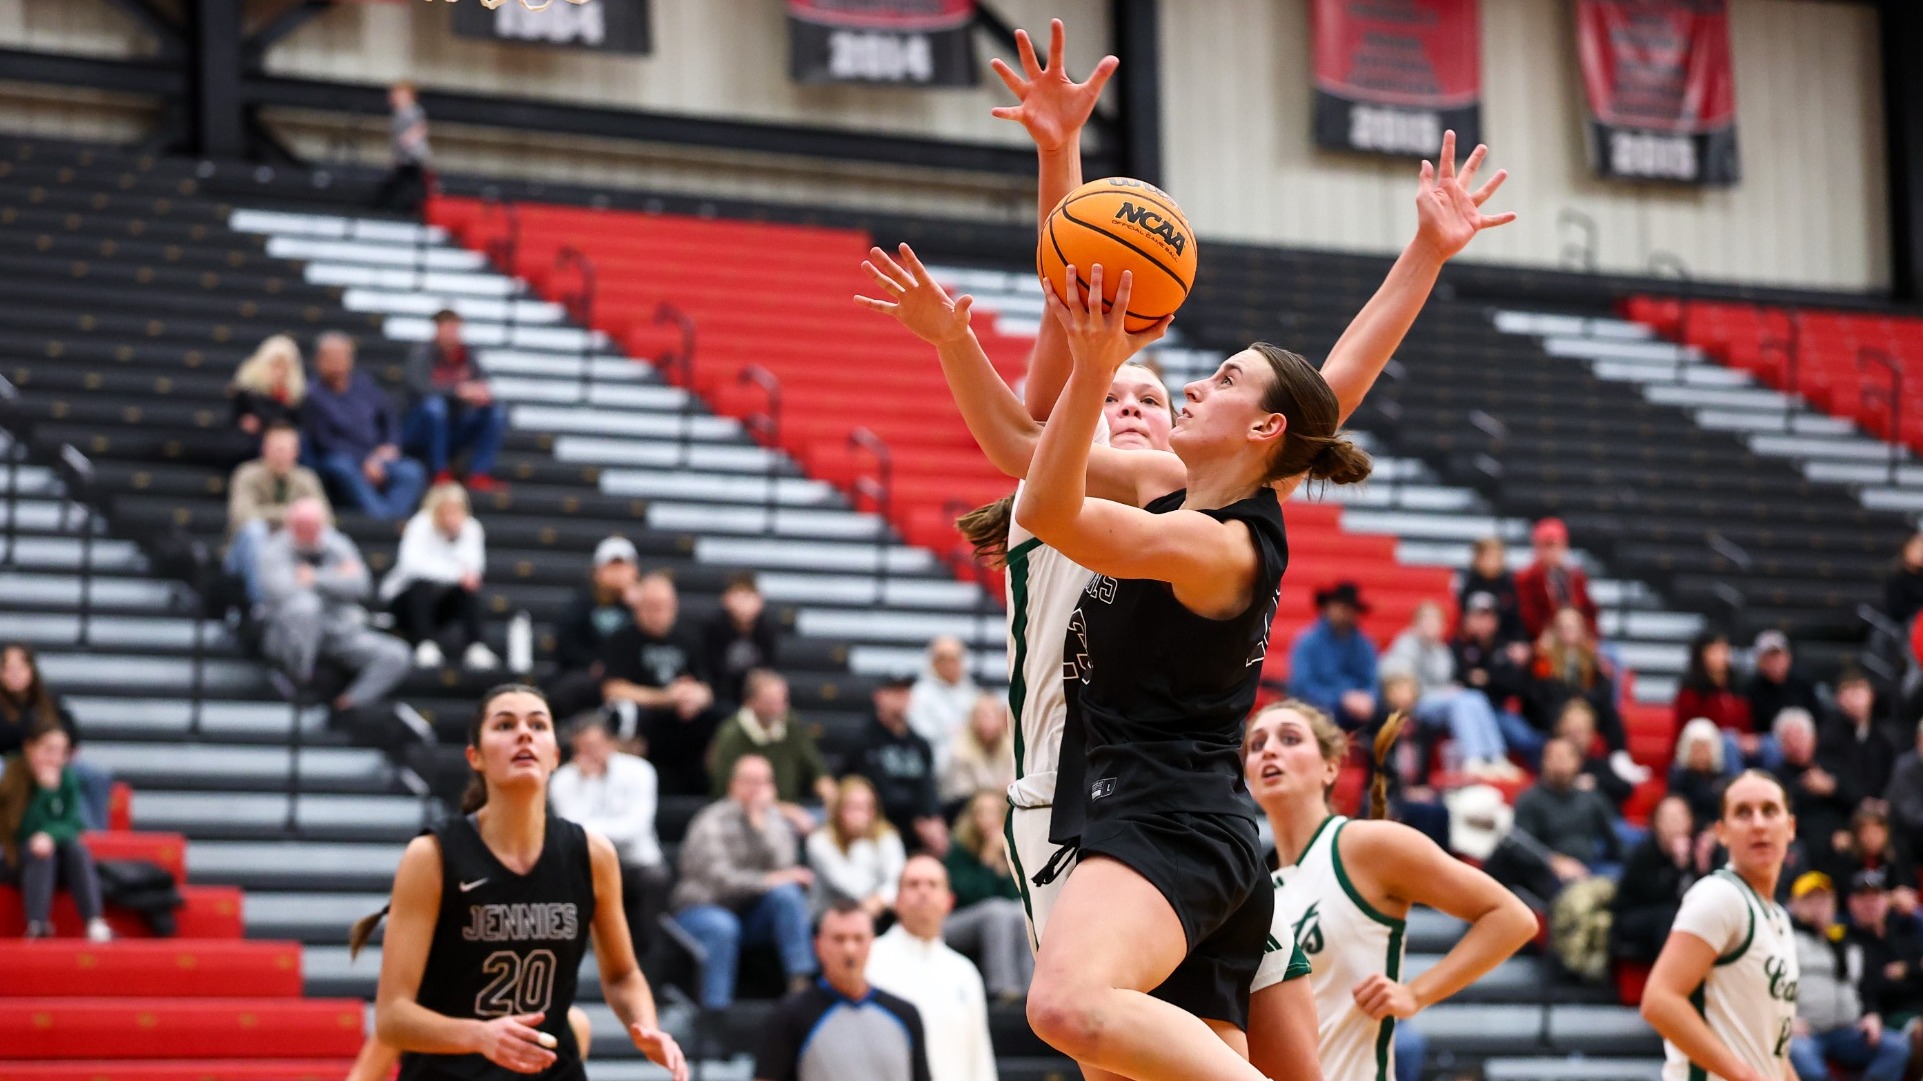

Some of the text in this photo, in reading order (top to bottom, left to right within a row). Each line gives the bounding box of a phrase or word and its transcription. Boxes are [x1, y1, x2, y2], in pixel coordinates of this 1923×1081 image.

[1111, 219, 1145, 236] OFFICIAL
[1145, 232, 1165, 250] GAME
[1115, 202, 1185, 257] NCAA
[462, 903, 578, 941] JENNIES
[475, 950, 557, 1016] 20
